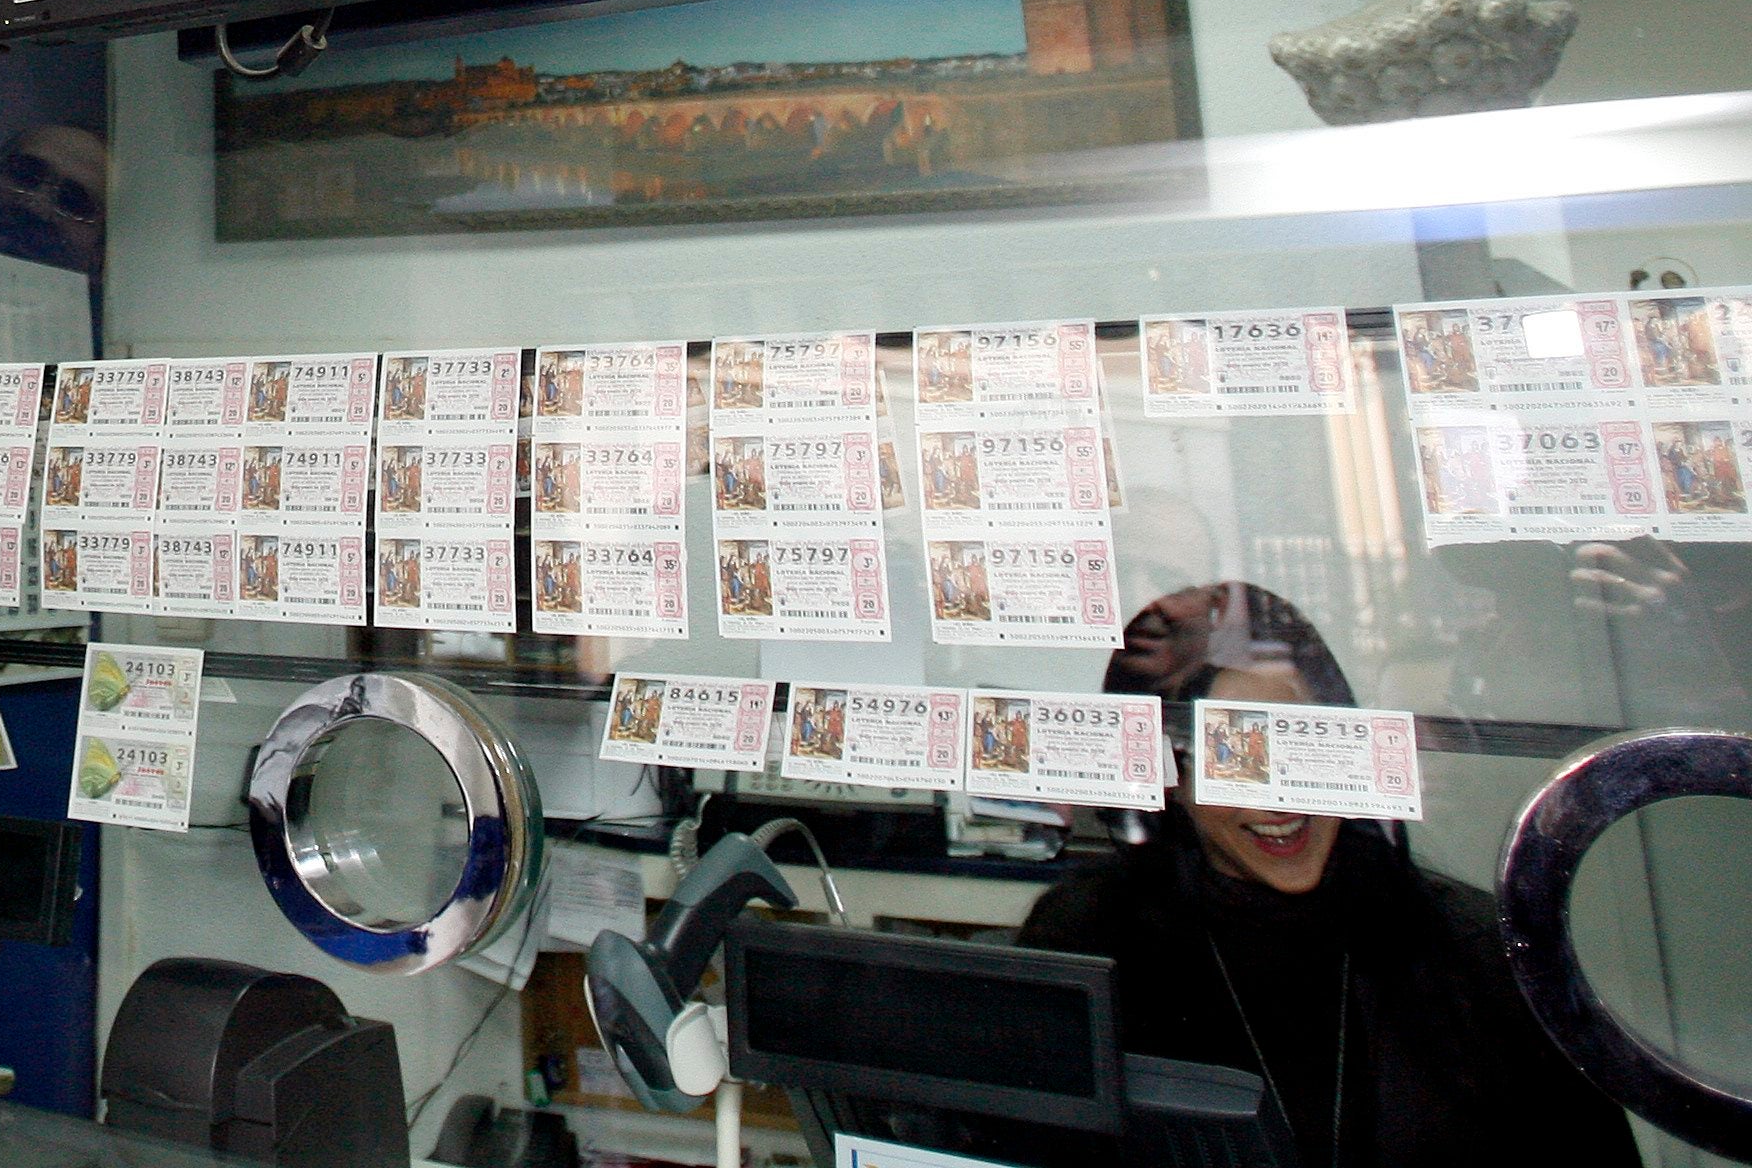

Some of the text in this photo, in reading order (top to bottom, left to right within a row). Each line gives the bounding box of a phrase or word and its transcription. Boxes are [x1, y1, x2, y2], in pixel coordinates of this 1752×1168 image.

[1214, 324, 1301, 339] 17636
[978, 334, 1057, 350] 97156
[770, 343, 840, 359] 75797
[432, 361, 491, 375] 37733
[591, 355, 655, 369] 33764
[97, 371, 145, 383] 33779
[173, 370, 224, 382] 38743
[295, 366, 348, 378] 74911
[983, 437, 1063, 454] 97156
[1499, 433, 1598, 450] 37063
[586, 449, 653, 464] 33764
[771, 442, 842, 457] 75797
[86, 452, 136, 464] 33779
[167, 454, 217, 466] 38743
[287, 453, 340, 465] 74911
[427, 452, 486, 466] 37733
[79, 536, 130, 549] 33779
[162, 541, 212, 553] 38743
[283, 543, 337, 556] 74911
[425, 547, 484, 561] 37733
[587, 549, 654, 563] 33764
[776, 547, 849, 563] 75797
[991, 549, 1075, 566] 97156
[125, 661, 175, 677] 24103
[670, 688, 739, 703] 84615
[851, 697, 928, 714] 54976
[1038, 707, 1120, 726] 36033
[1275, 719, 1369, 739] 92519
[117, 748, 168, 764] 24103
[1133, 764, 1146, 773] 20
[1387, 776, 1401, 785] 20
